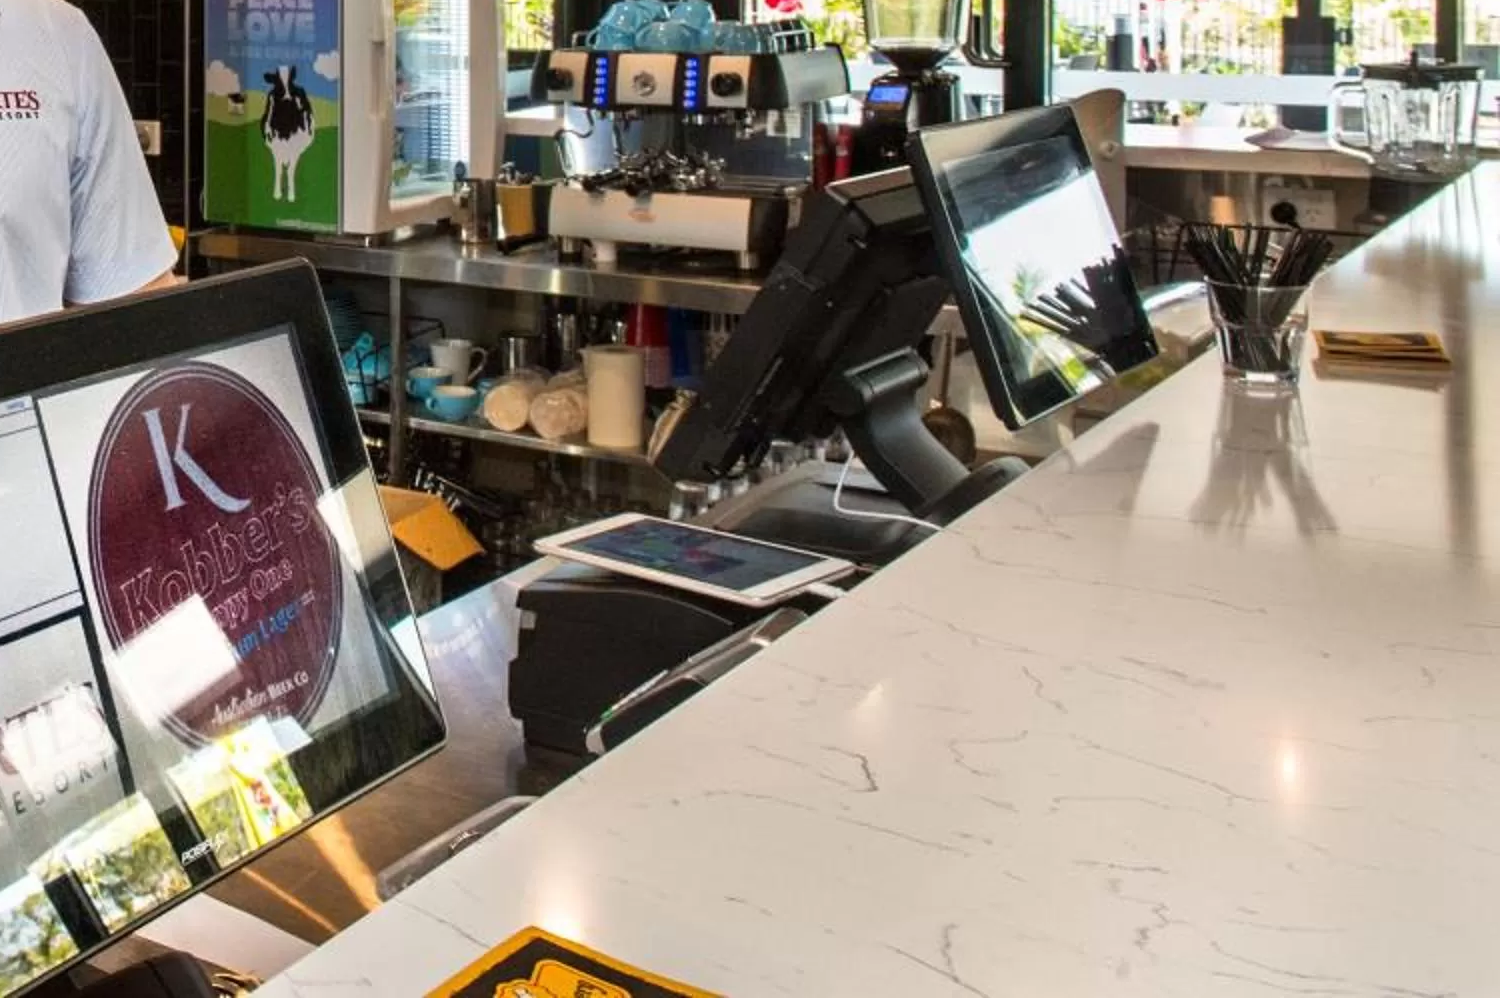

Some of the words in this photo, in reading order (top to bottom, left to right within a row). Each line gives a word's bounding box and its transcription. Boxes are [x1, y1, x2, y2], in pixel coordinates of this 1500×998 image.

[227, 11, 315, 42] LOVE
[141, 403, 251, 513] K
[120, 481, 311, 636] Kobber's
[212, 588, 250, 629] ppy
